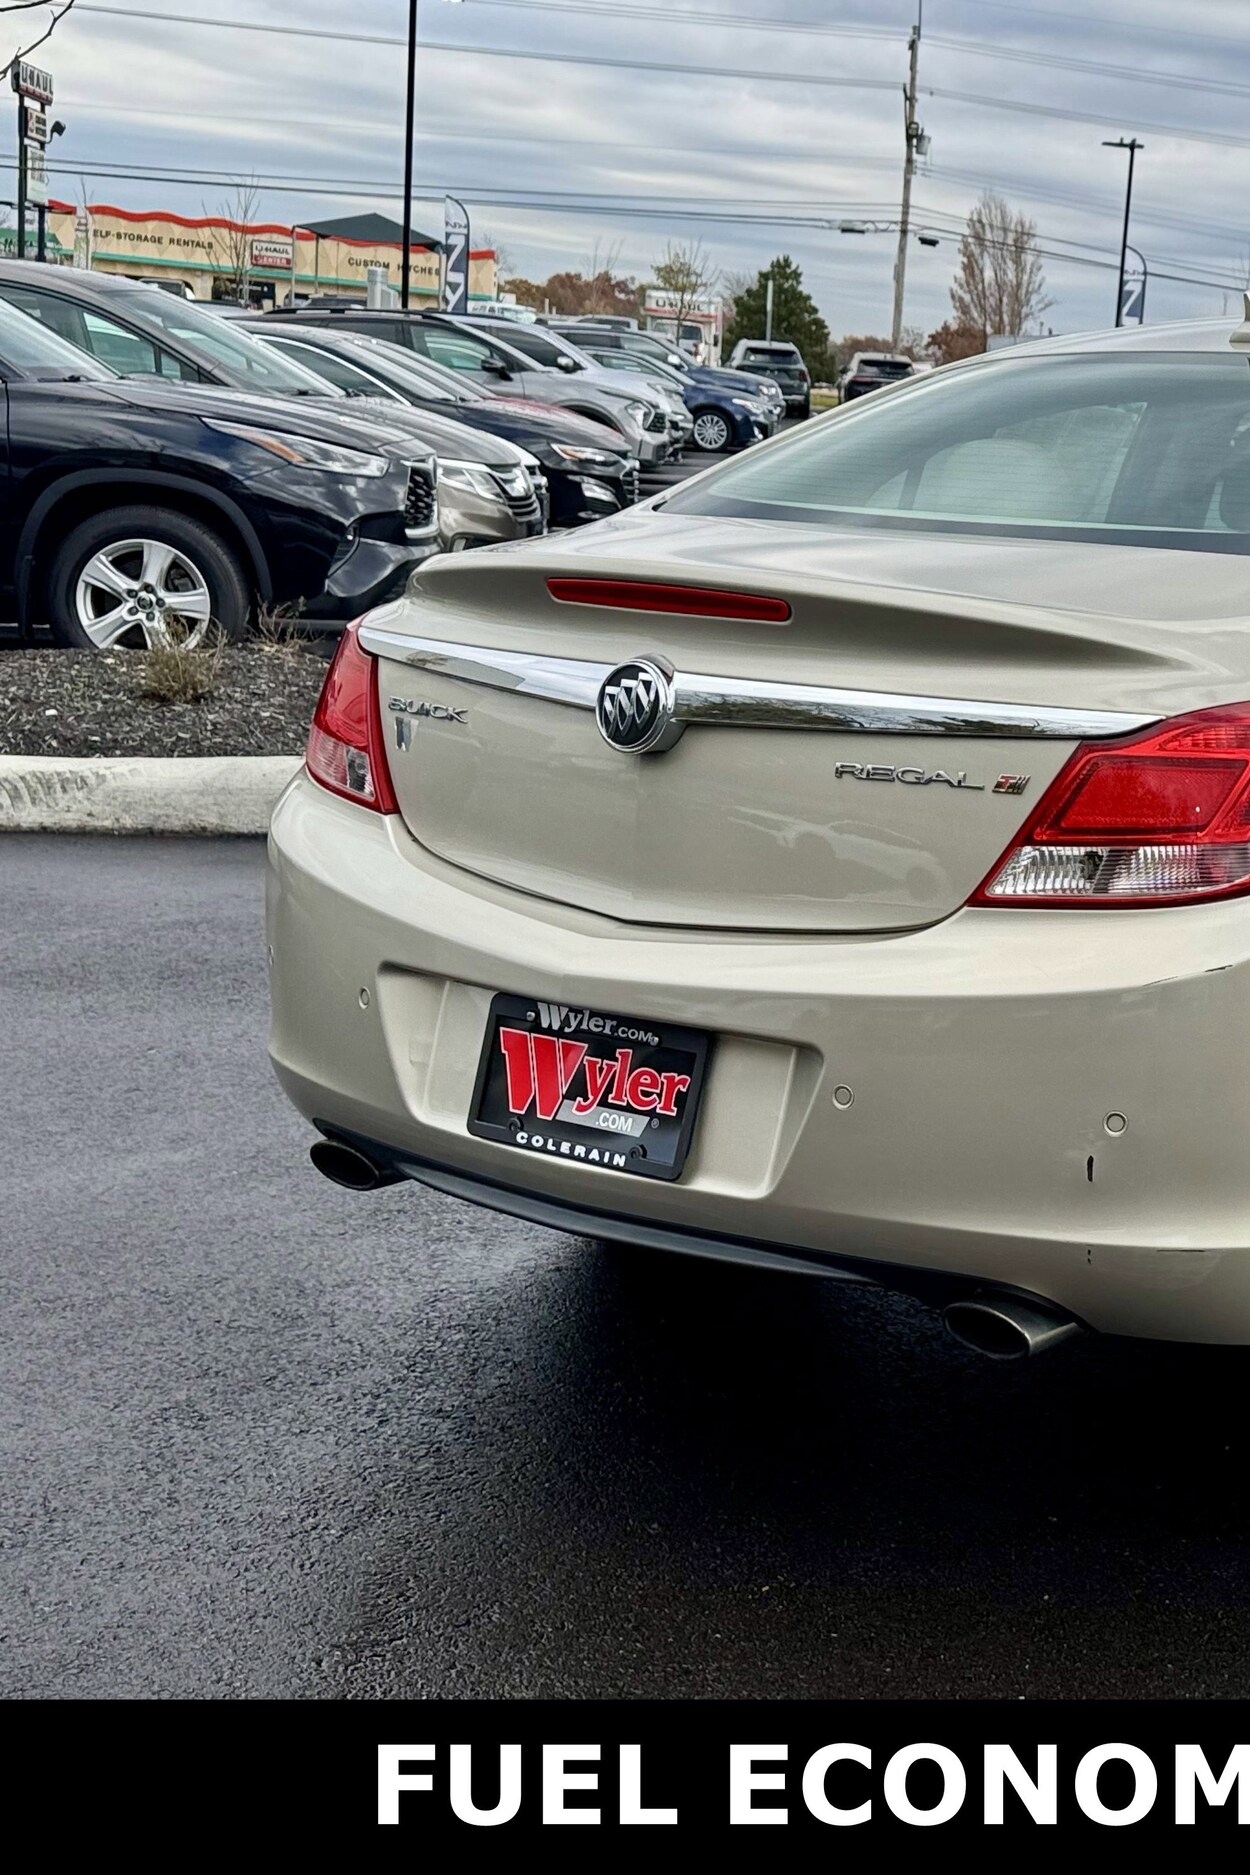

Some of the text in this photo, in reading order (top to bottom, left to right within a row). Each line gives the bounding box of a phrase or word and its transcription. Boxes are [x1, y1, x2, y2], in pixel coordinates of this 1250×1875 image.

[92, 228, 214, 250] ELF-STORAGE RENTALS
[347, 256, 440, 277] CUSTOM HTCHES
[388, 695, 468, 724] BUICK
[834, 761, 985, 791] REGAL
[499, 1026, 691, 1121] Wyler
[515, 1131, 627, 1168] COLERAIN
